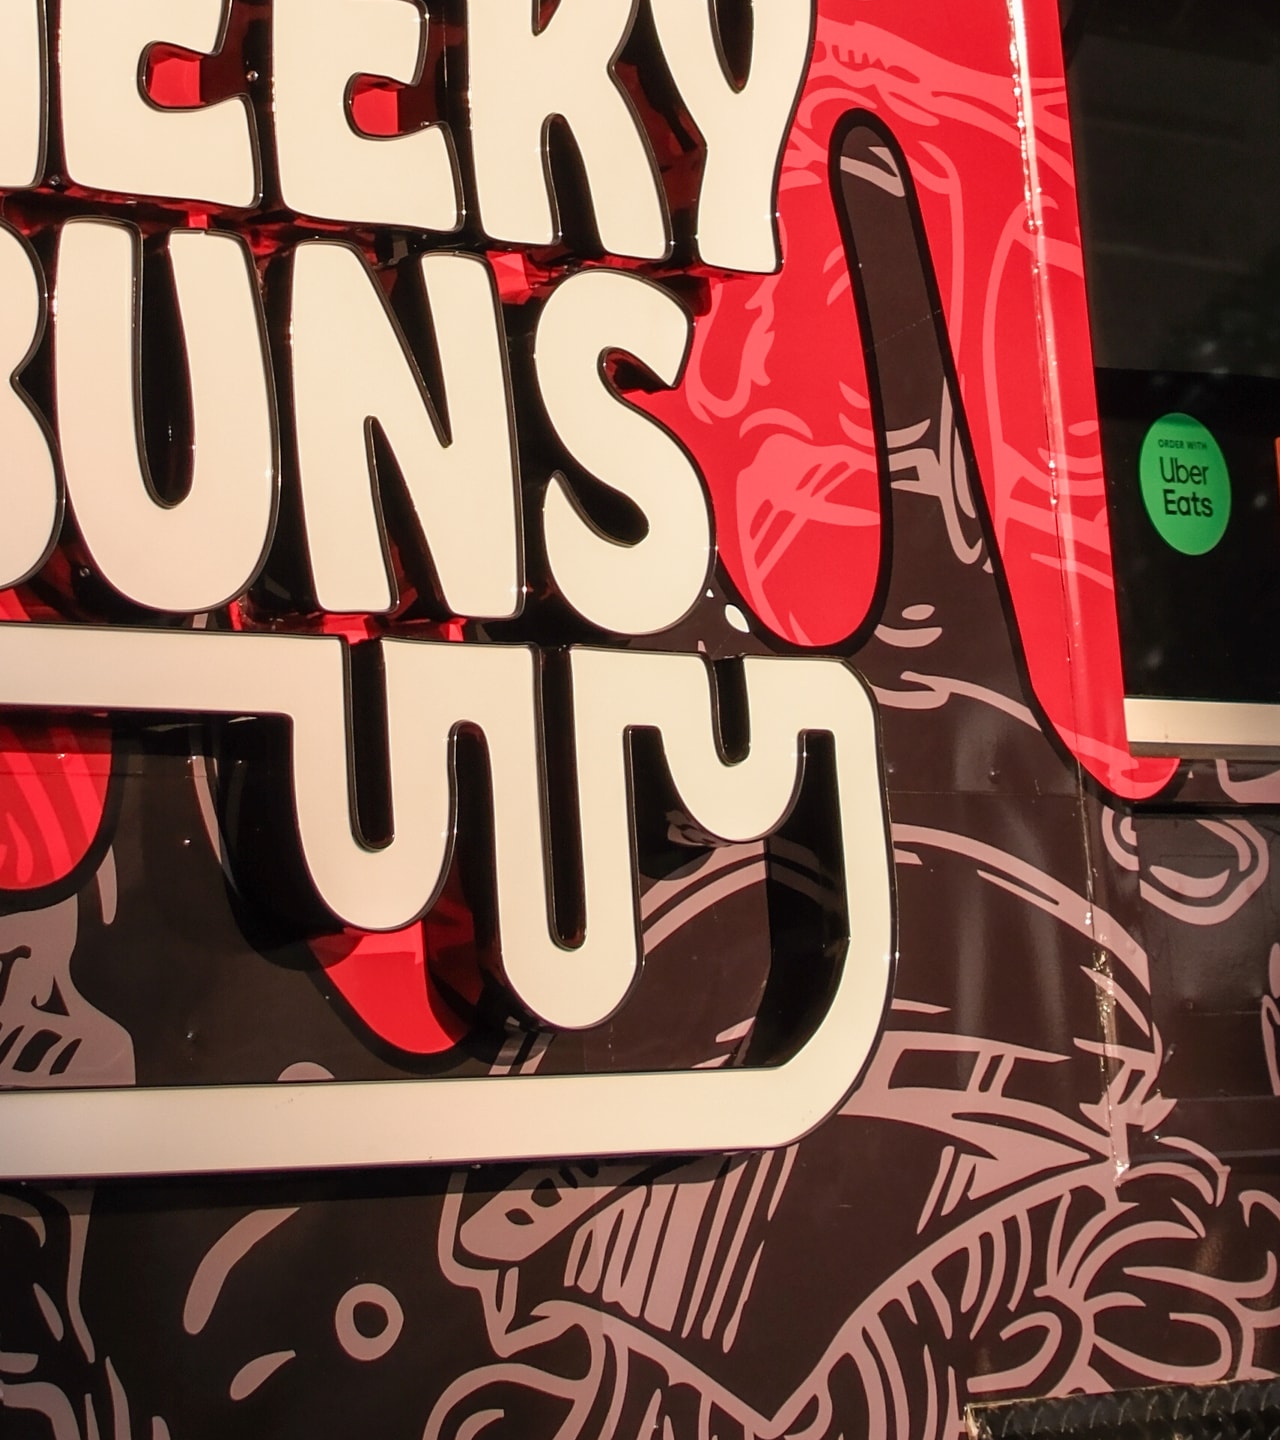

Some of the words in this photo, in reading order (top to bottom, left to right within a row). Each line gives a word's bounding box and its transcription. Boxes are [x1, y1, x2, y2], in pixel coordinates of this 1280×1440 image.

[1157, 438, 1185, 449] ORDER
[1186, 440, 1208, 451] WITH
[1159, 456, 1209, 486] Uber
[1162, 489, 1214, 519] Eats
